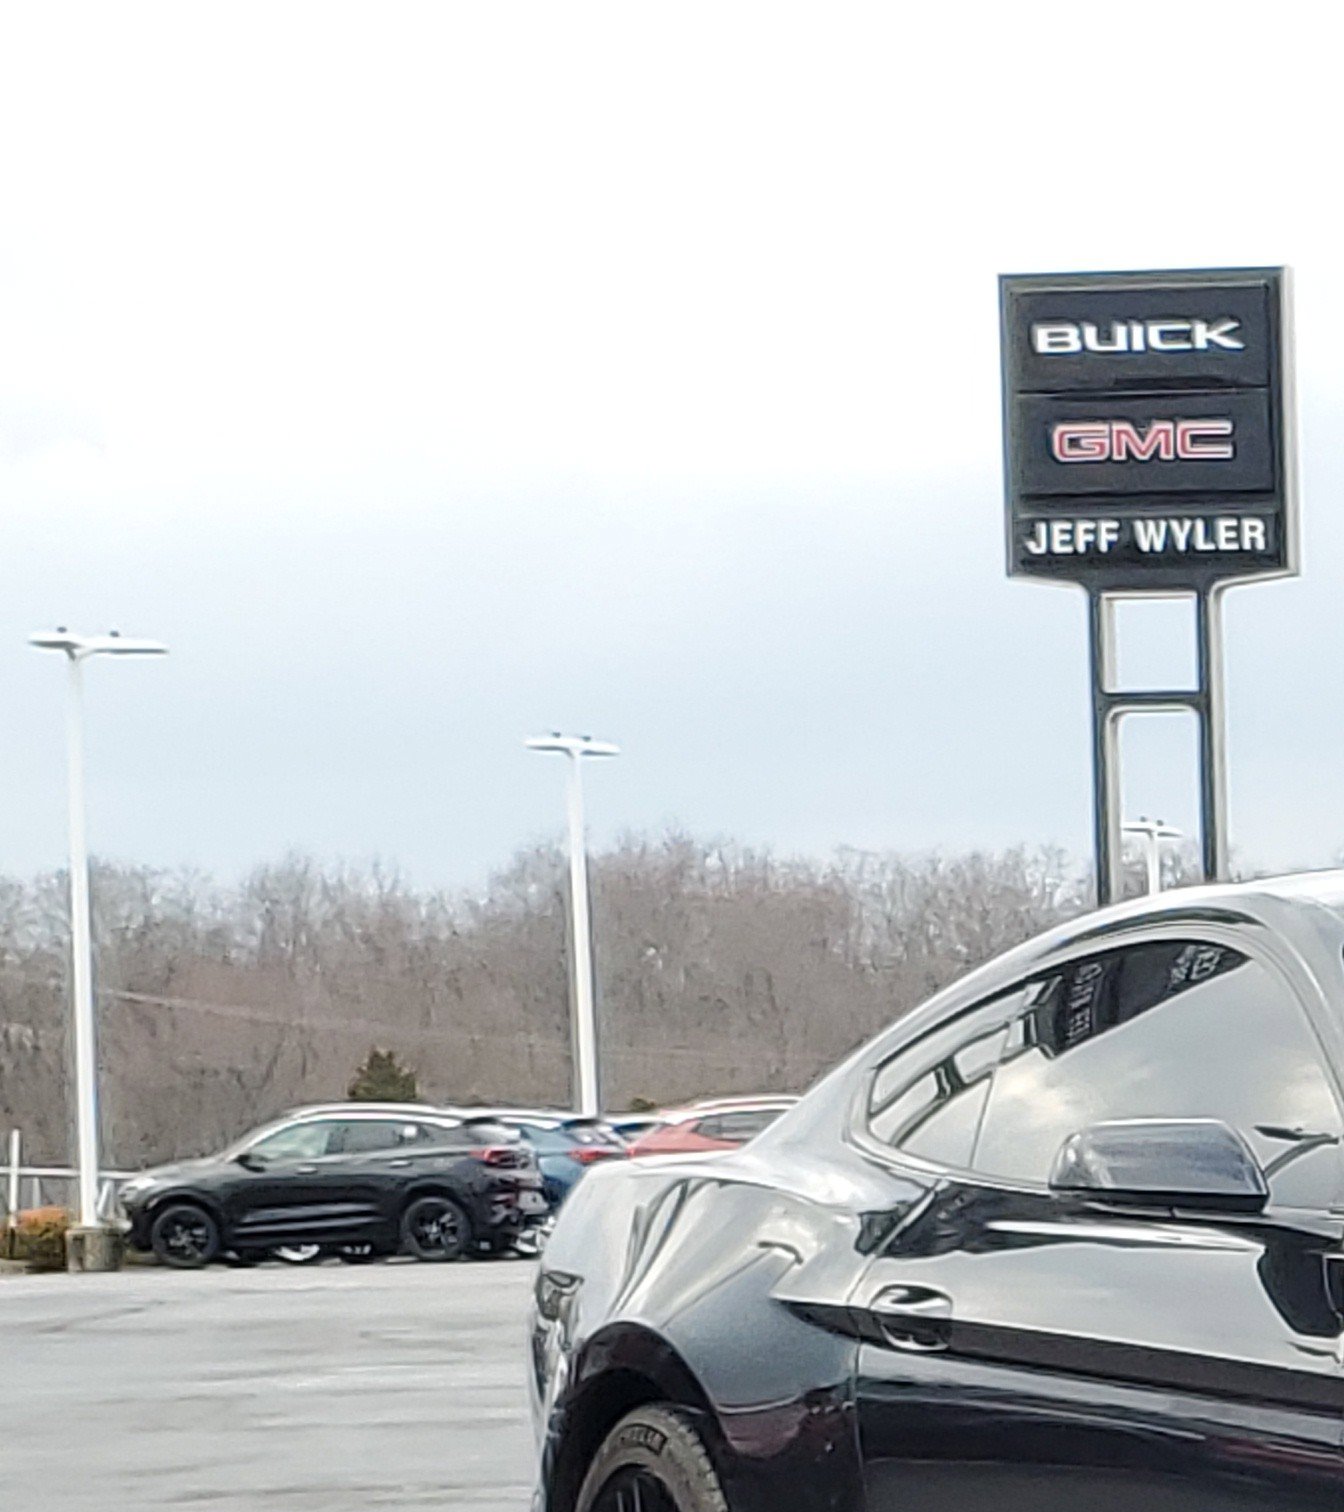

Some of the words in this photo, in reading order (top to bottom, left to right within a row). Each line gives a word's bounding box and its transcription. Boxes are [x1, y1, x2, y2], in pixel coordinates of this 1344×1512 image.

[1031, 320, 1246, 353] BUICK
[1053, 420, 1234, 462] GMC
[1025, 520, 1120, 554] JEFF
[1133, 517, 1266, 553] WYLER
